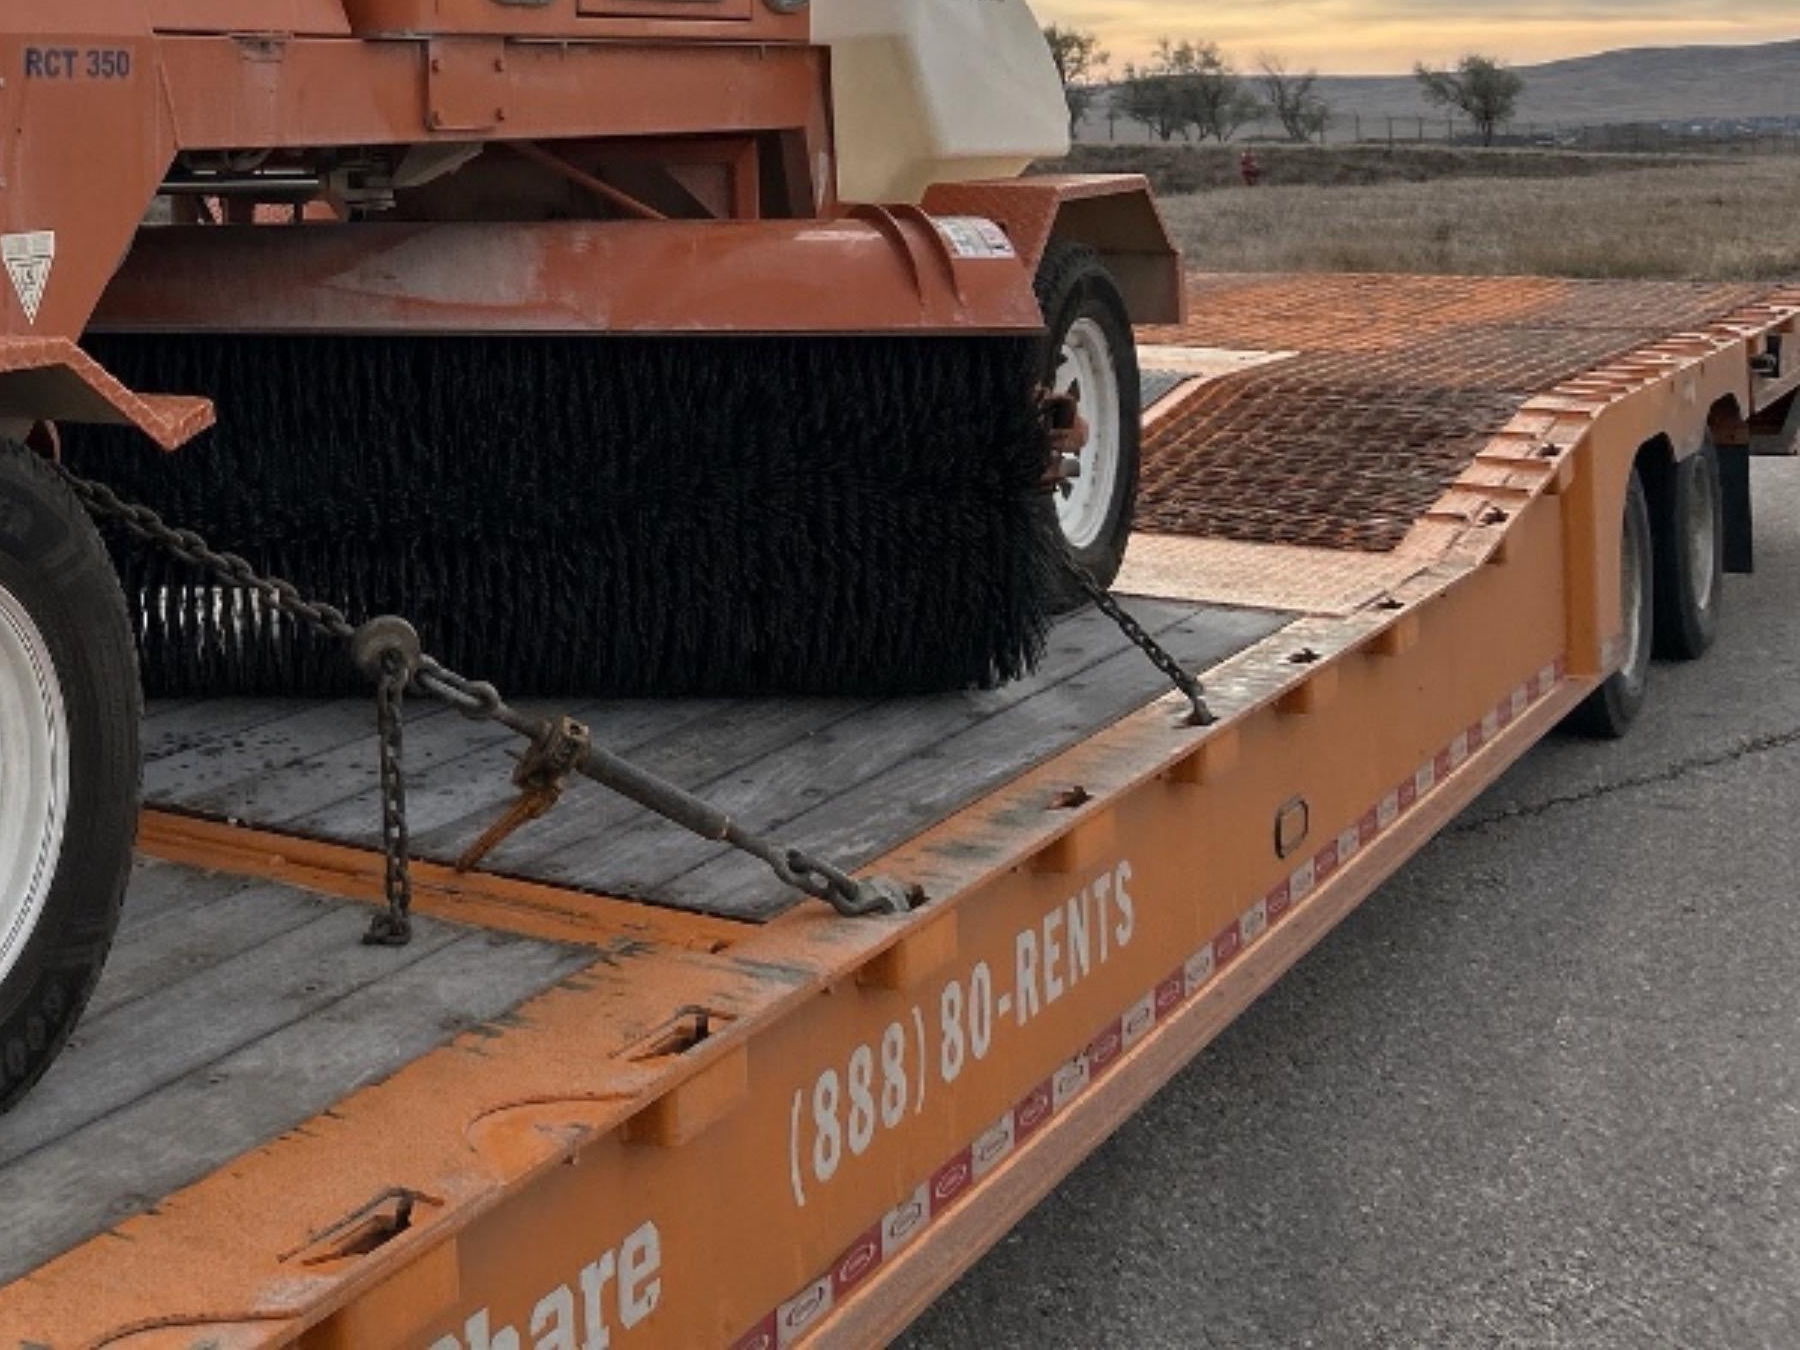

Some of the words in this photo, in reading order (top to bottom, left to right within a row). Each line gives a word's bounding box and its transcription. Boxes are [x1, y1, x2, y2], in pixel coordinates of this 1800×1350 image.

[25, 47, 79, 78] RCT
[86, 49, 130, 78] 350
[791, 1004, 926, 1207] (888)
[941, 859, 1135, 1083] 80-RENTS
